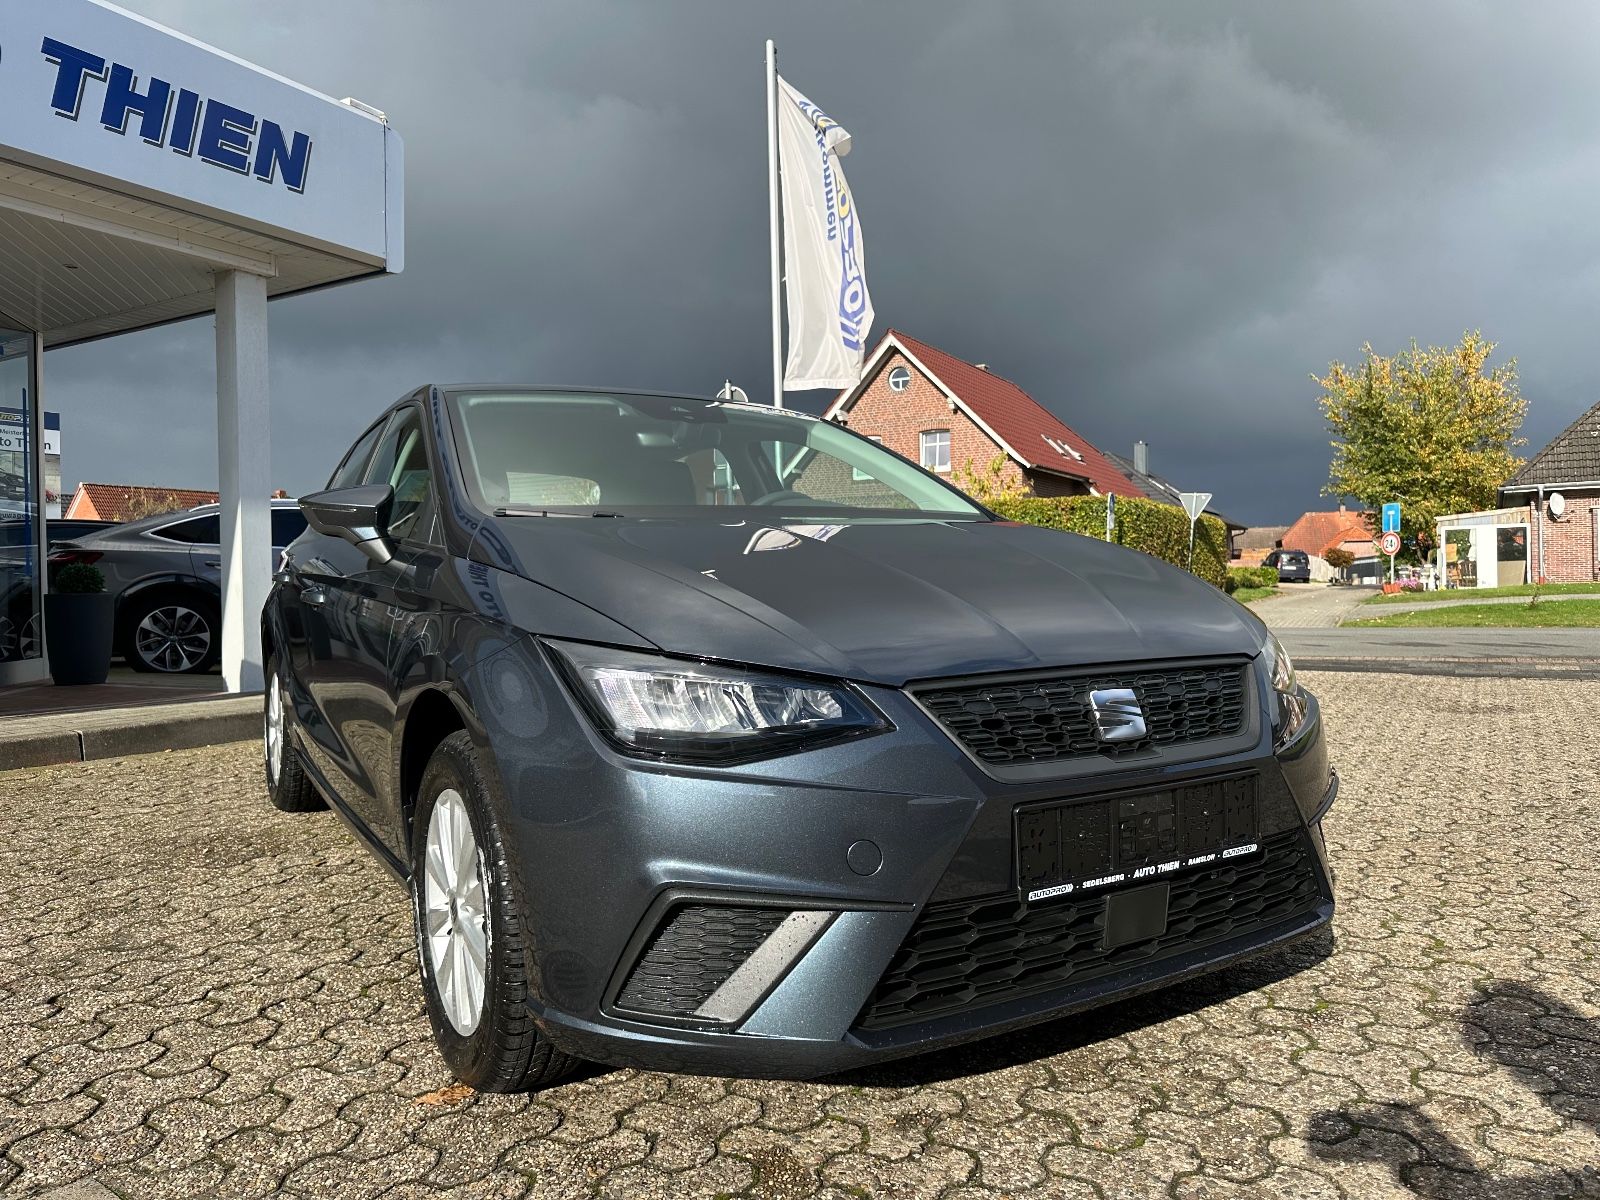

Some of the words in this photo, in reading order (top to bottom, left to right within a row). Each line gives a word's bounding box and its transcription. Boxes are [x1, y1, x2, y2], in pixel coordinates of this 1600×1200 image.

[41, 36, 312, 194] THIEN
[1029, 885, 1070, 901] AUTOPRO
[1082, 874, 1124, 889] SEDELSBERG
[1133, 866, 1156, 879] AUTO
[1157, 860, 1181, 873] THIEN
